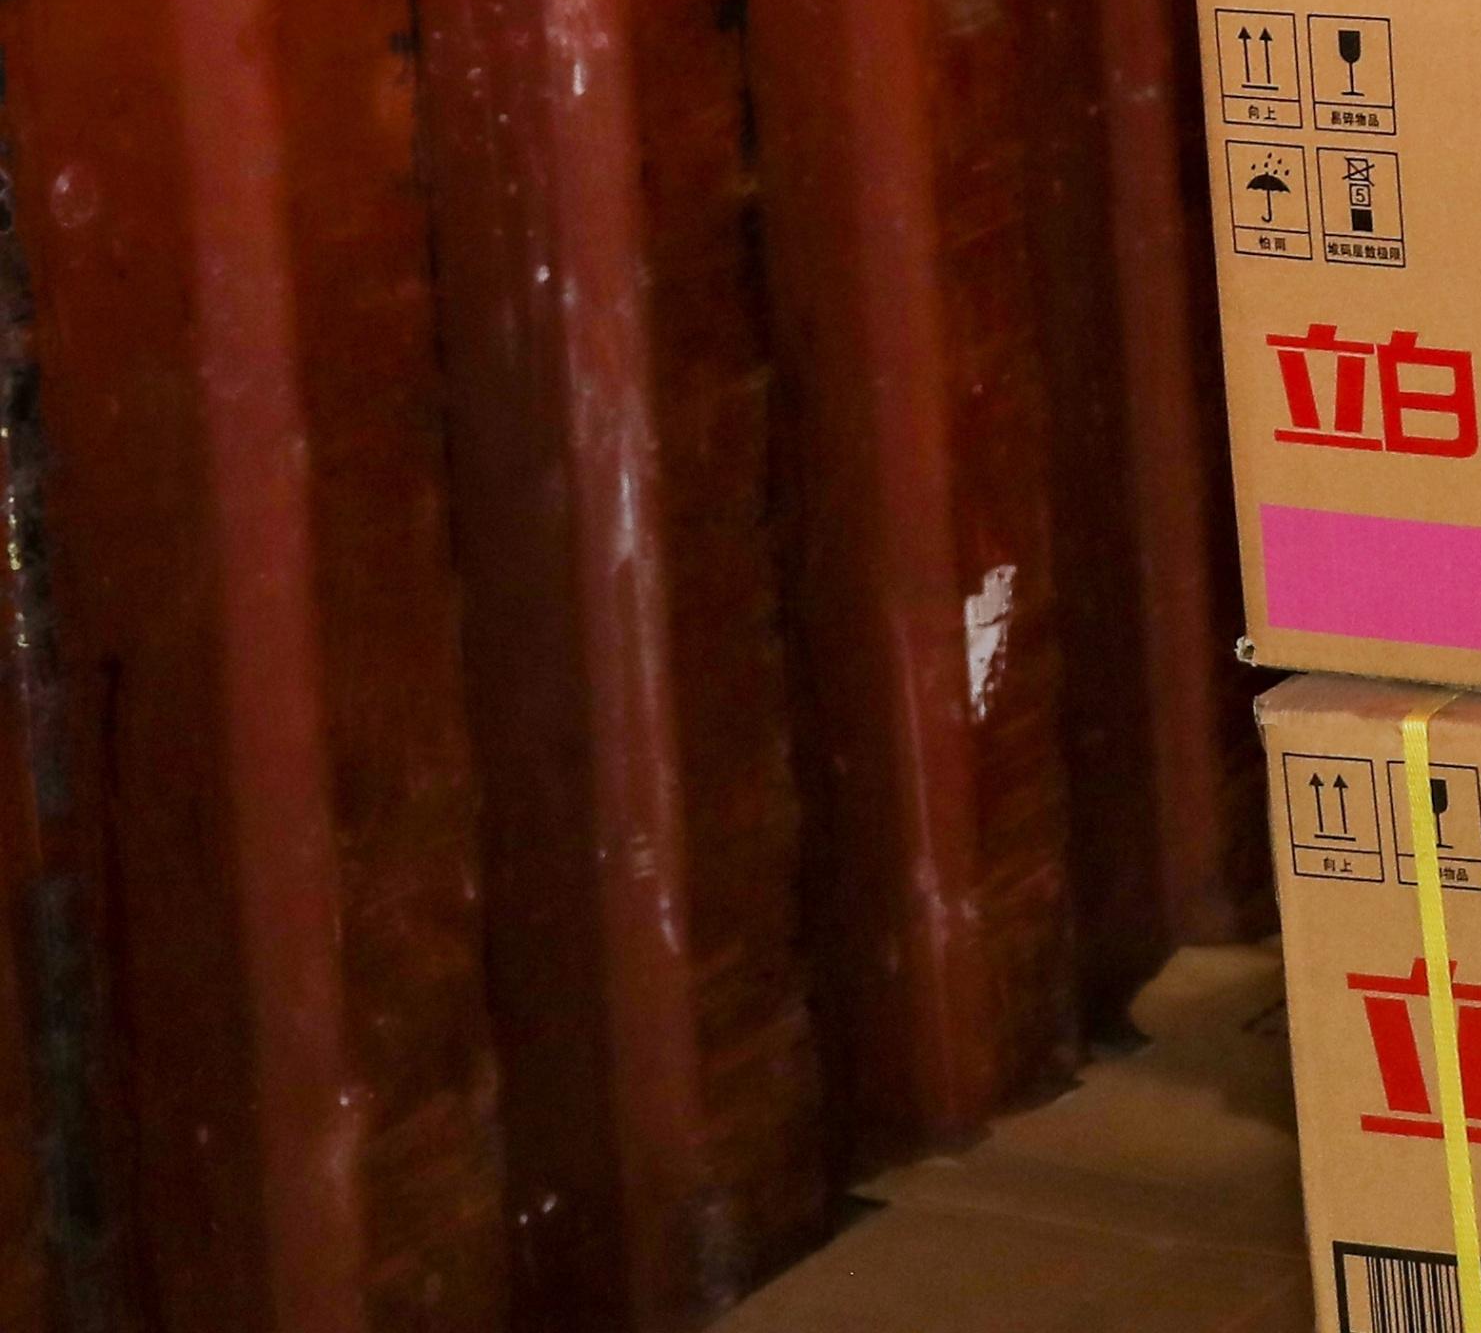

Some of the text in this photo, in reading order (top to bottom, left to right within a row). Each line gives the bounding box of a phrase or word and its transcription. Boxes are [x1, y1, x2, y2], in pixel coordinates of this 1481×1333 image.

[1248, 105, 1276, 120] 向上
[1331, 111, 1379, 127] 易碎物品
[1259, 237, 1286, 251] 怕雨
[1267, 325, 1478, 457] 立白
[1323, 856, 1353, 874] 向上
